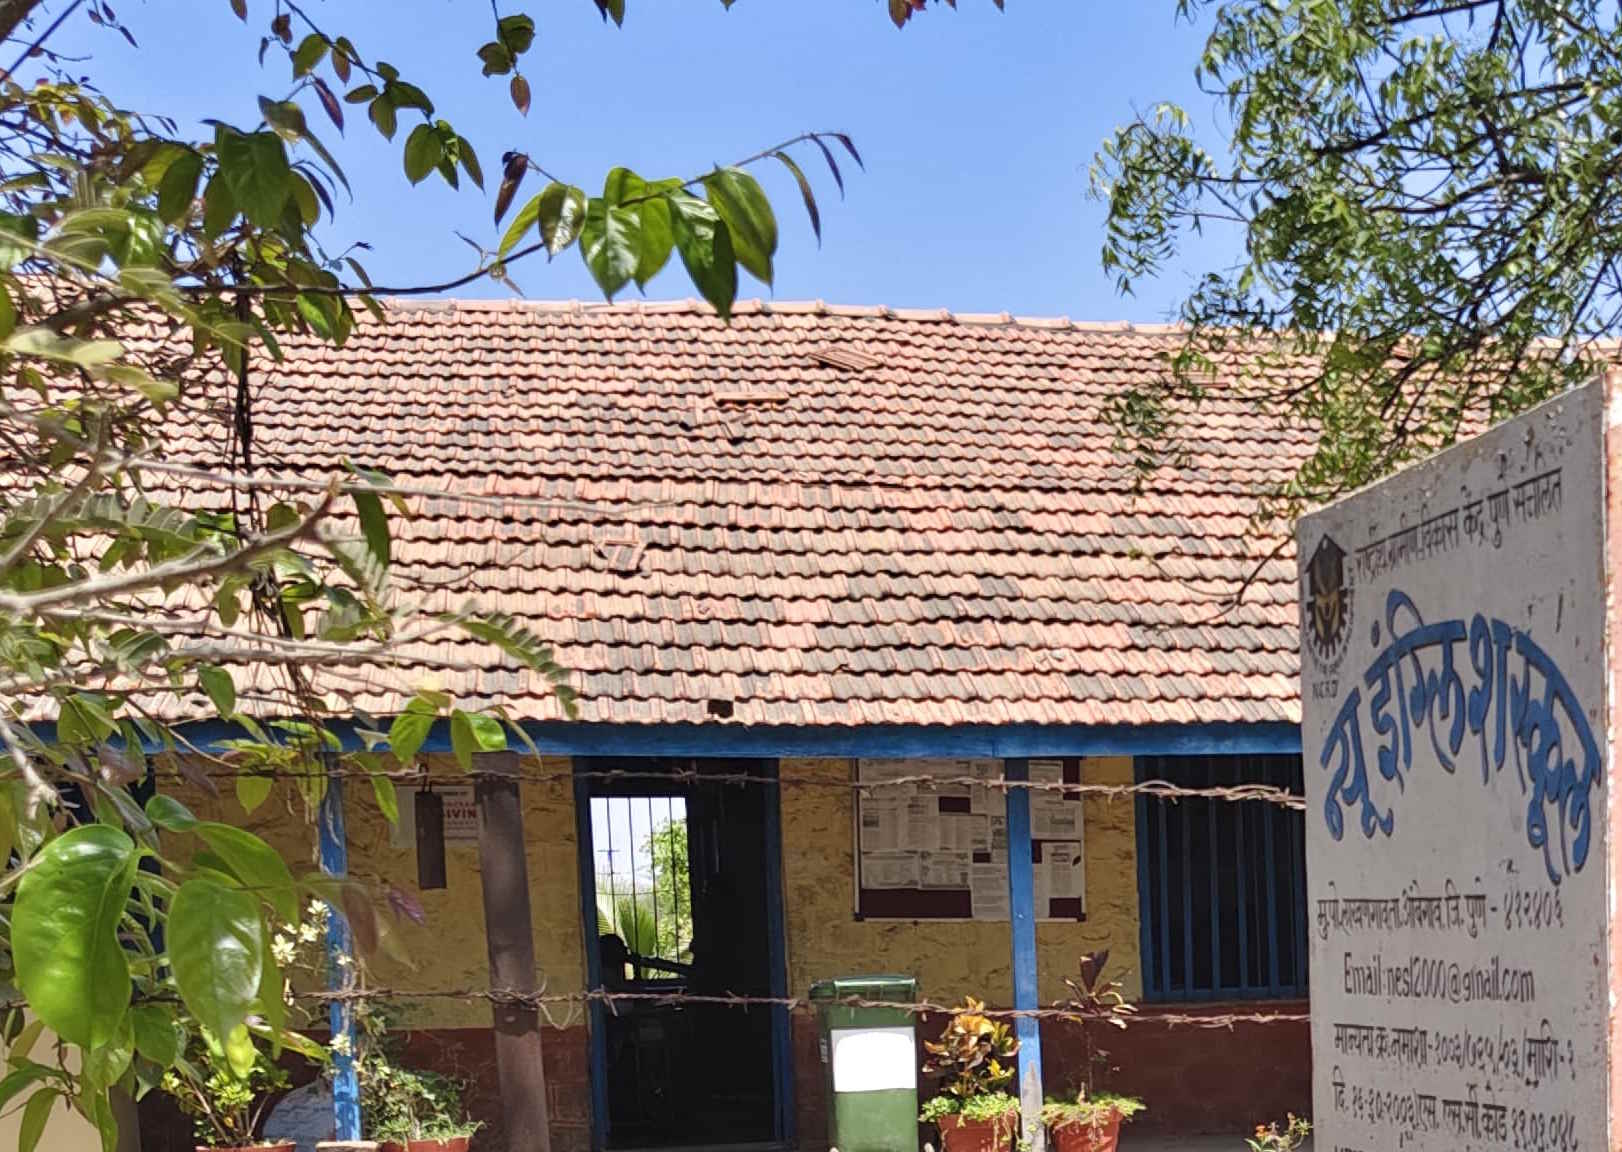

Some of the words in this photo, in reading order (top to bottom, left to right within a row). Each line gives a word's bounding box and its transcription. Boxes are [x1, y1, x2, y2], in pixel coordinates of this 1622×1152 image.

[1320, 687, 1394, 841] न्यू
[1364, 588, 1512, 793] इंग्लिश
[1510, 629, 1600, 885] स्कूल
